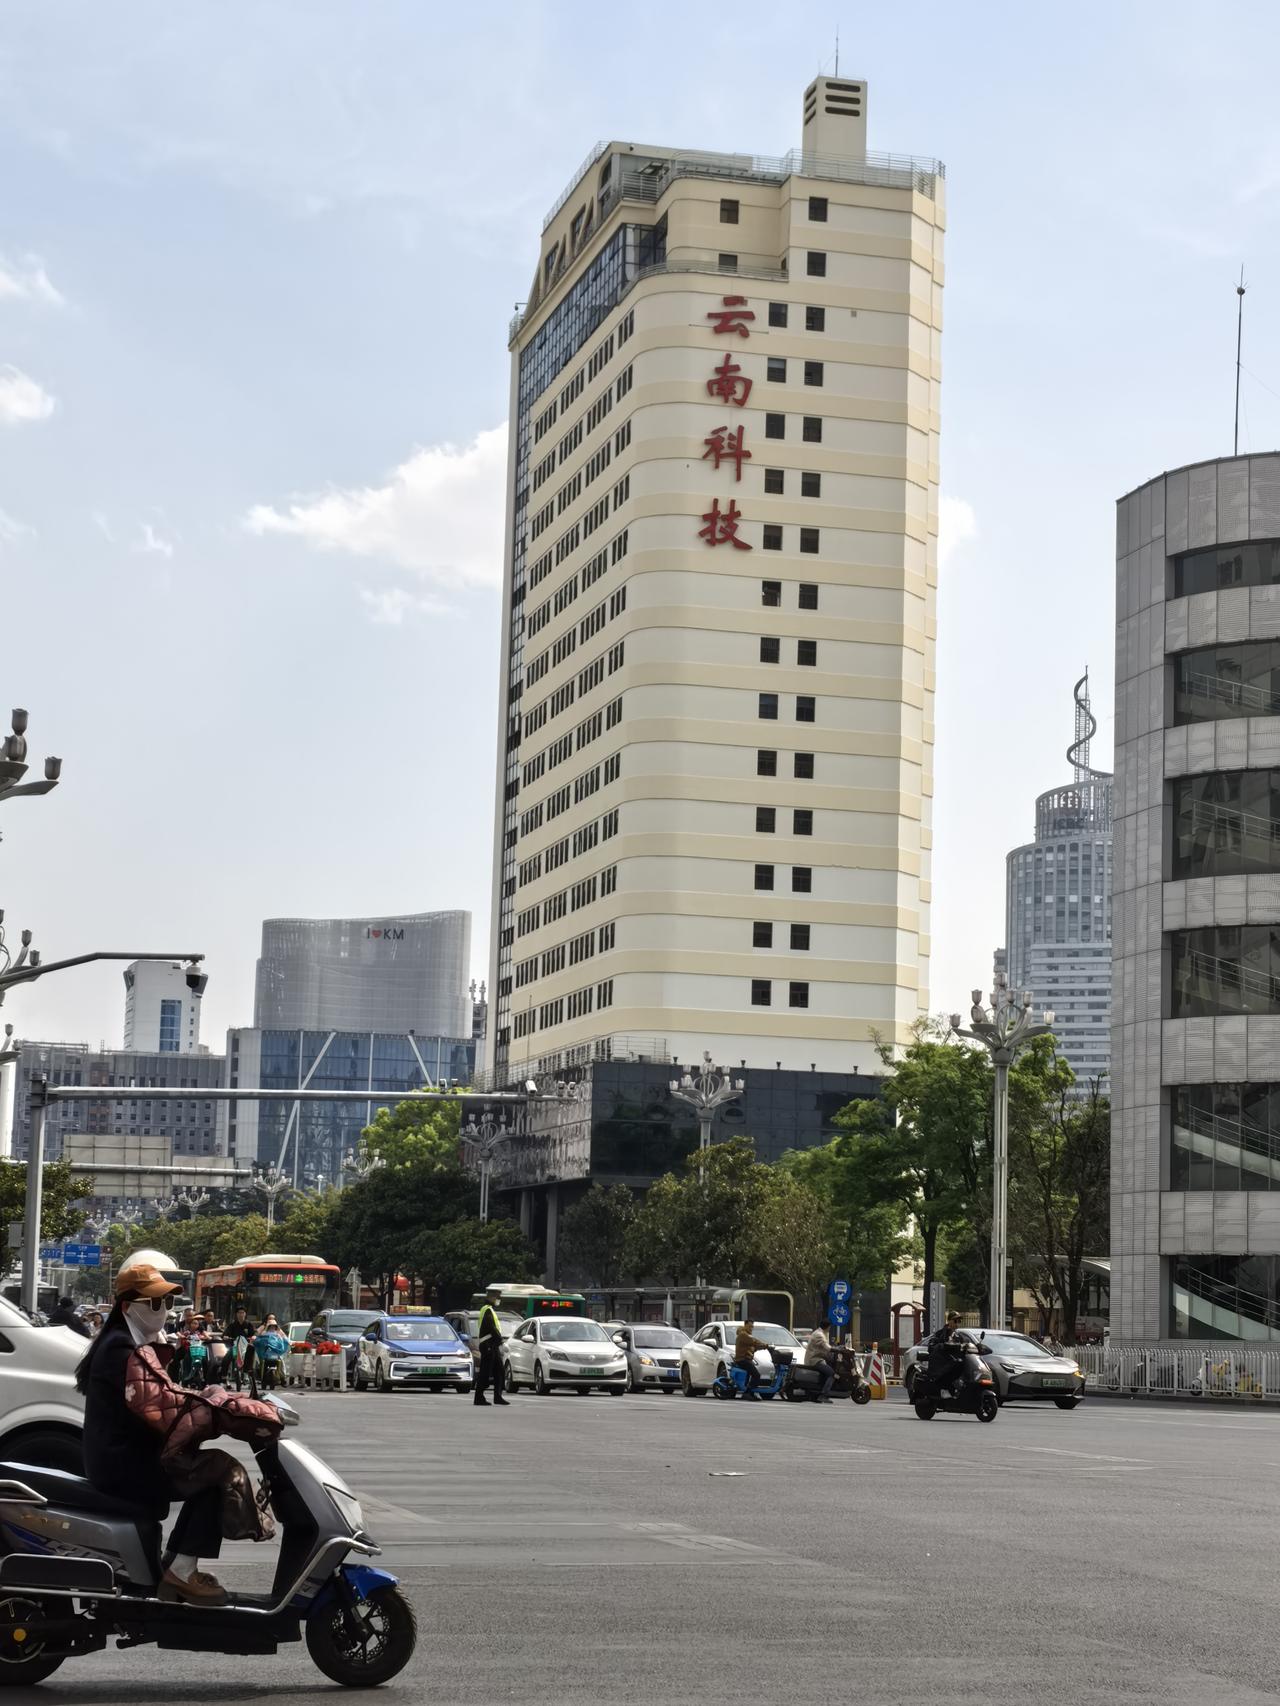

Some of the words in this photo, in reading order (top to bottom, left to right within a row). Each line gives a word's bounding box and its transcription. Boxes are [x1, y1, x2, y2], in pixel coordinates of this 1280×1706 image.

[698, 295, 755, 551] 云南科技
[383, 928, 404, 940] KM
